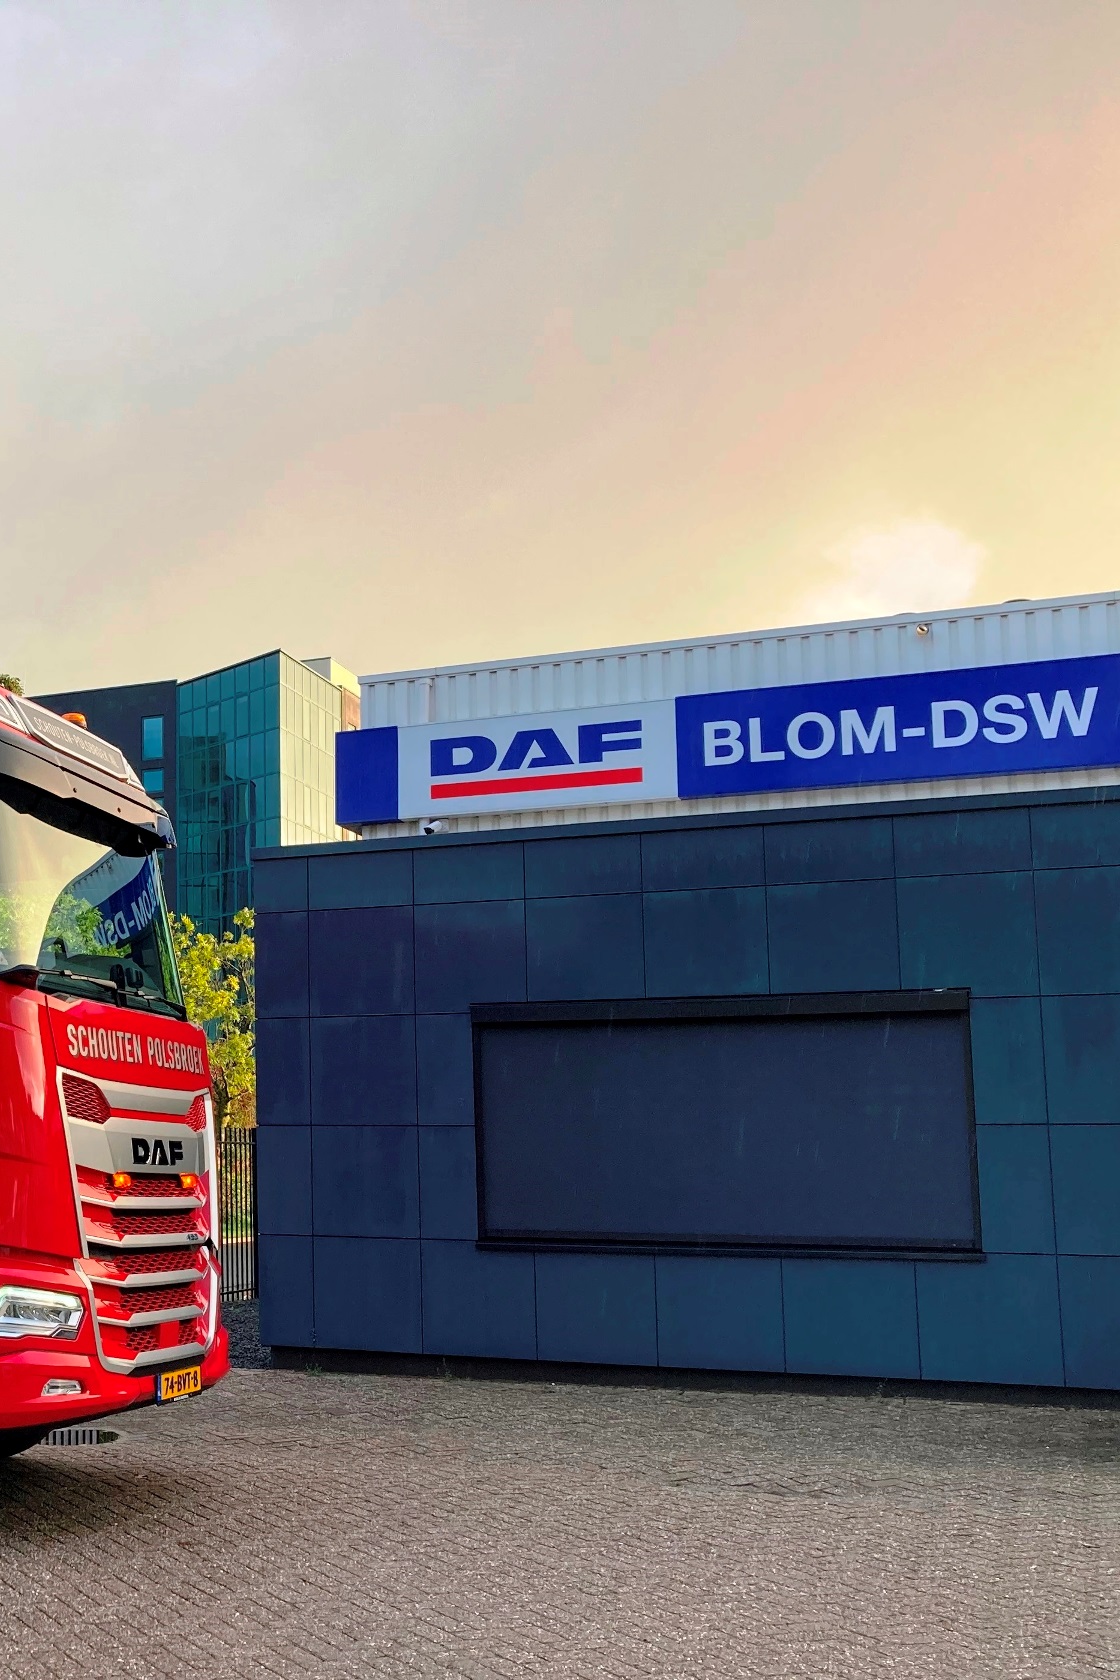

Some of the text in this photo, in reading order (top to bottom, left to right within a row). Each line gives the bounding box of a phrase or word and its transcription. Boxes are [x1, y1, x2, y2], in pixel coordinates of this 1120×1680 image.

[430, 719, 643, 777] DAF
[703, 686, 1099, 767] BLOM-DSW
[66, 1023, 205, 1075] SCHOUTEN POLSBROEK
[131, 1137, 184, 1166] DAF
[164, 1370, 199, 1395] 74-BVT-8
